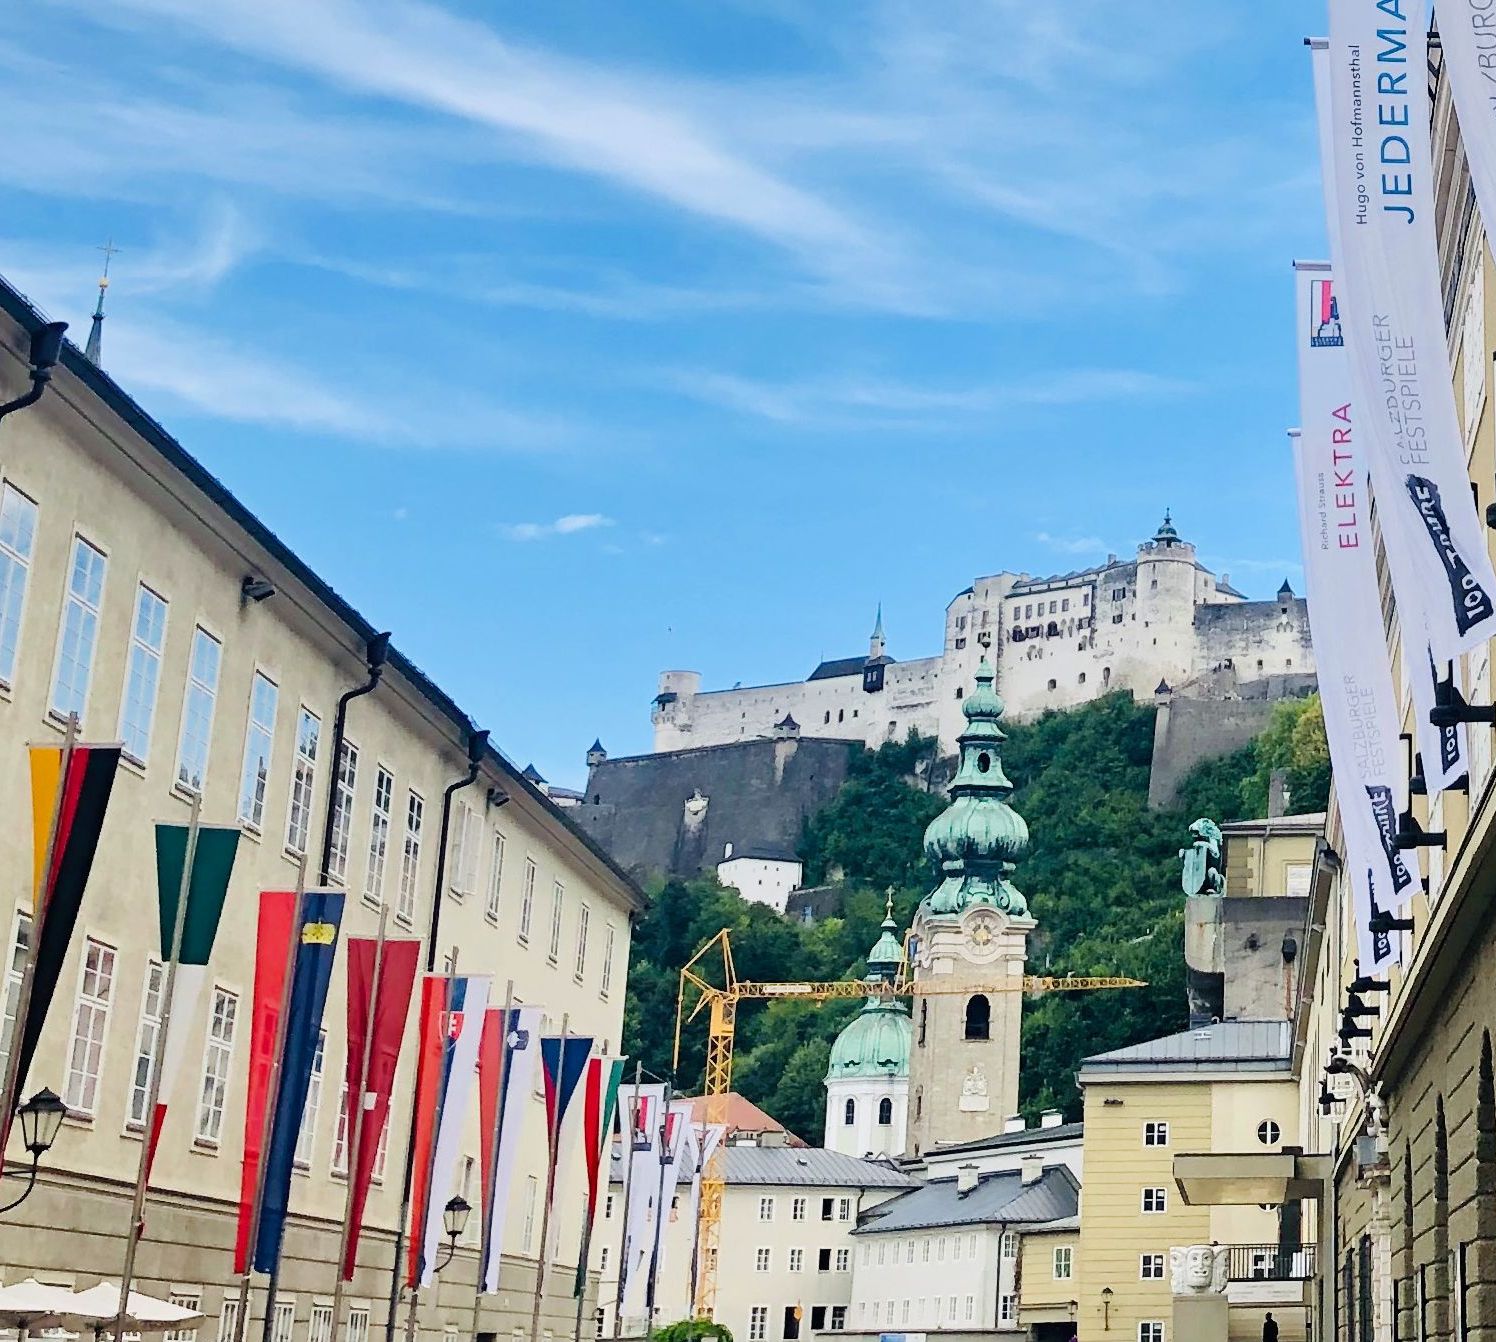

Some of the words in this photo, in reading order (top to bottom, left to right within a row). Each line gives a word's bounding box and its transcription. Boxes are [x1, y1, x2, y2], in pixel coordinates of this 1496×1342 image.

[1347, 44, 1363, 147] Hofmannsthal
[1354, 152, 1365, 180] von
[1355, 185, 1370, 225] Hugo
[1395, 336, 1430, 465] FESTSPIELE
[1317, 472, 1326, 509] Strauss
[1331, 403, 1359, 549] ELEKTRA
[1318, 512, 1329, 550] Richard
[1461, 573, 1485, 619] 100
[1360, 687, 1386, 777] FESTSPIELE
[1445, 726, 1456, 761] 100
